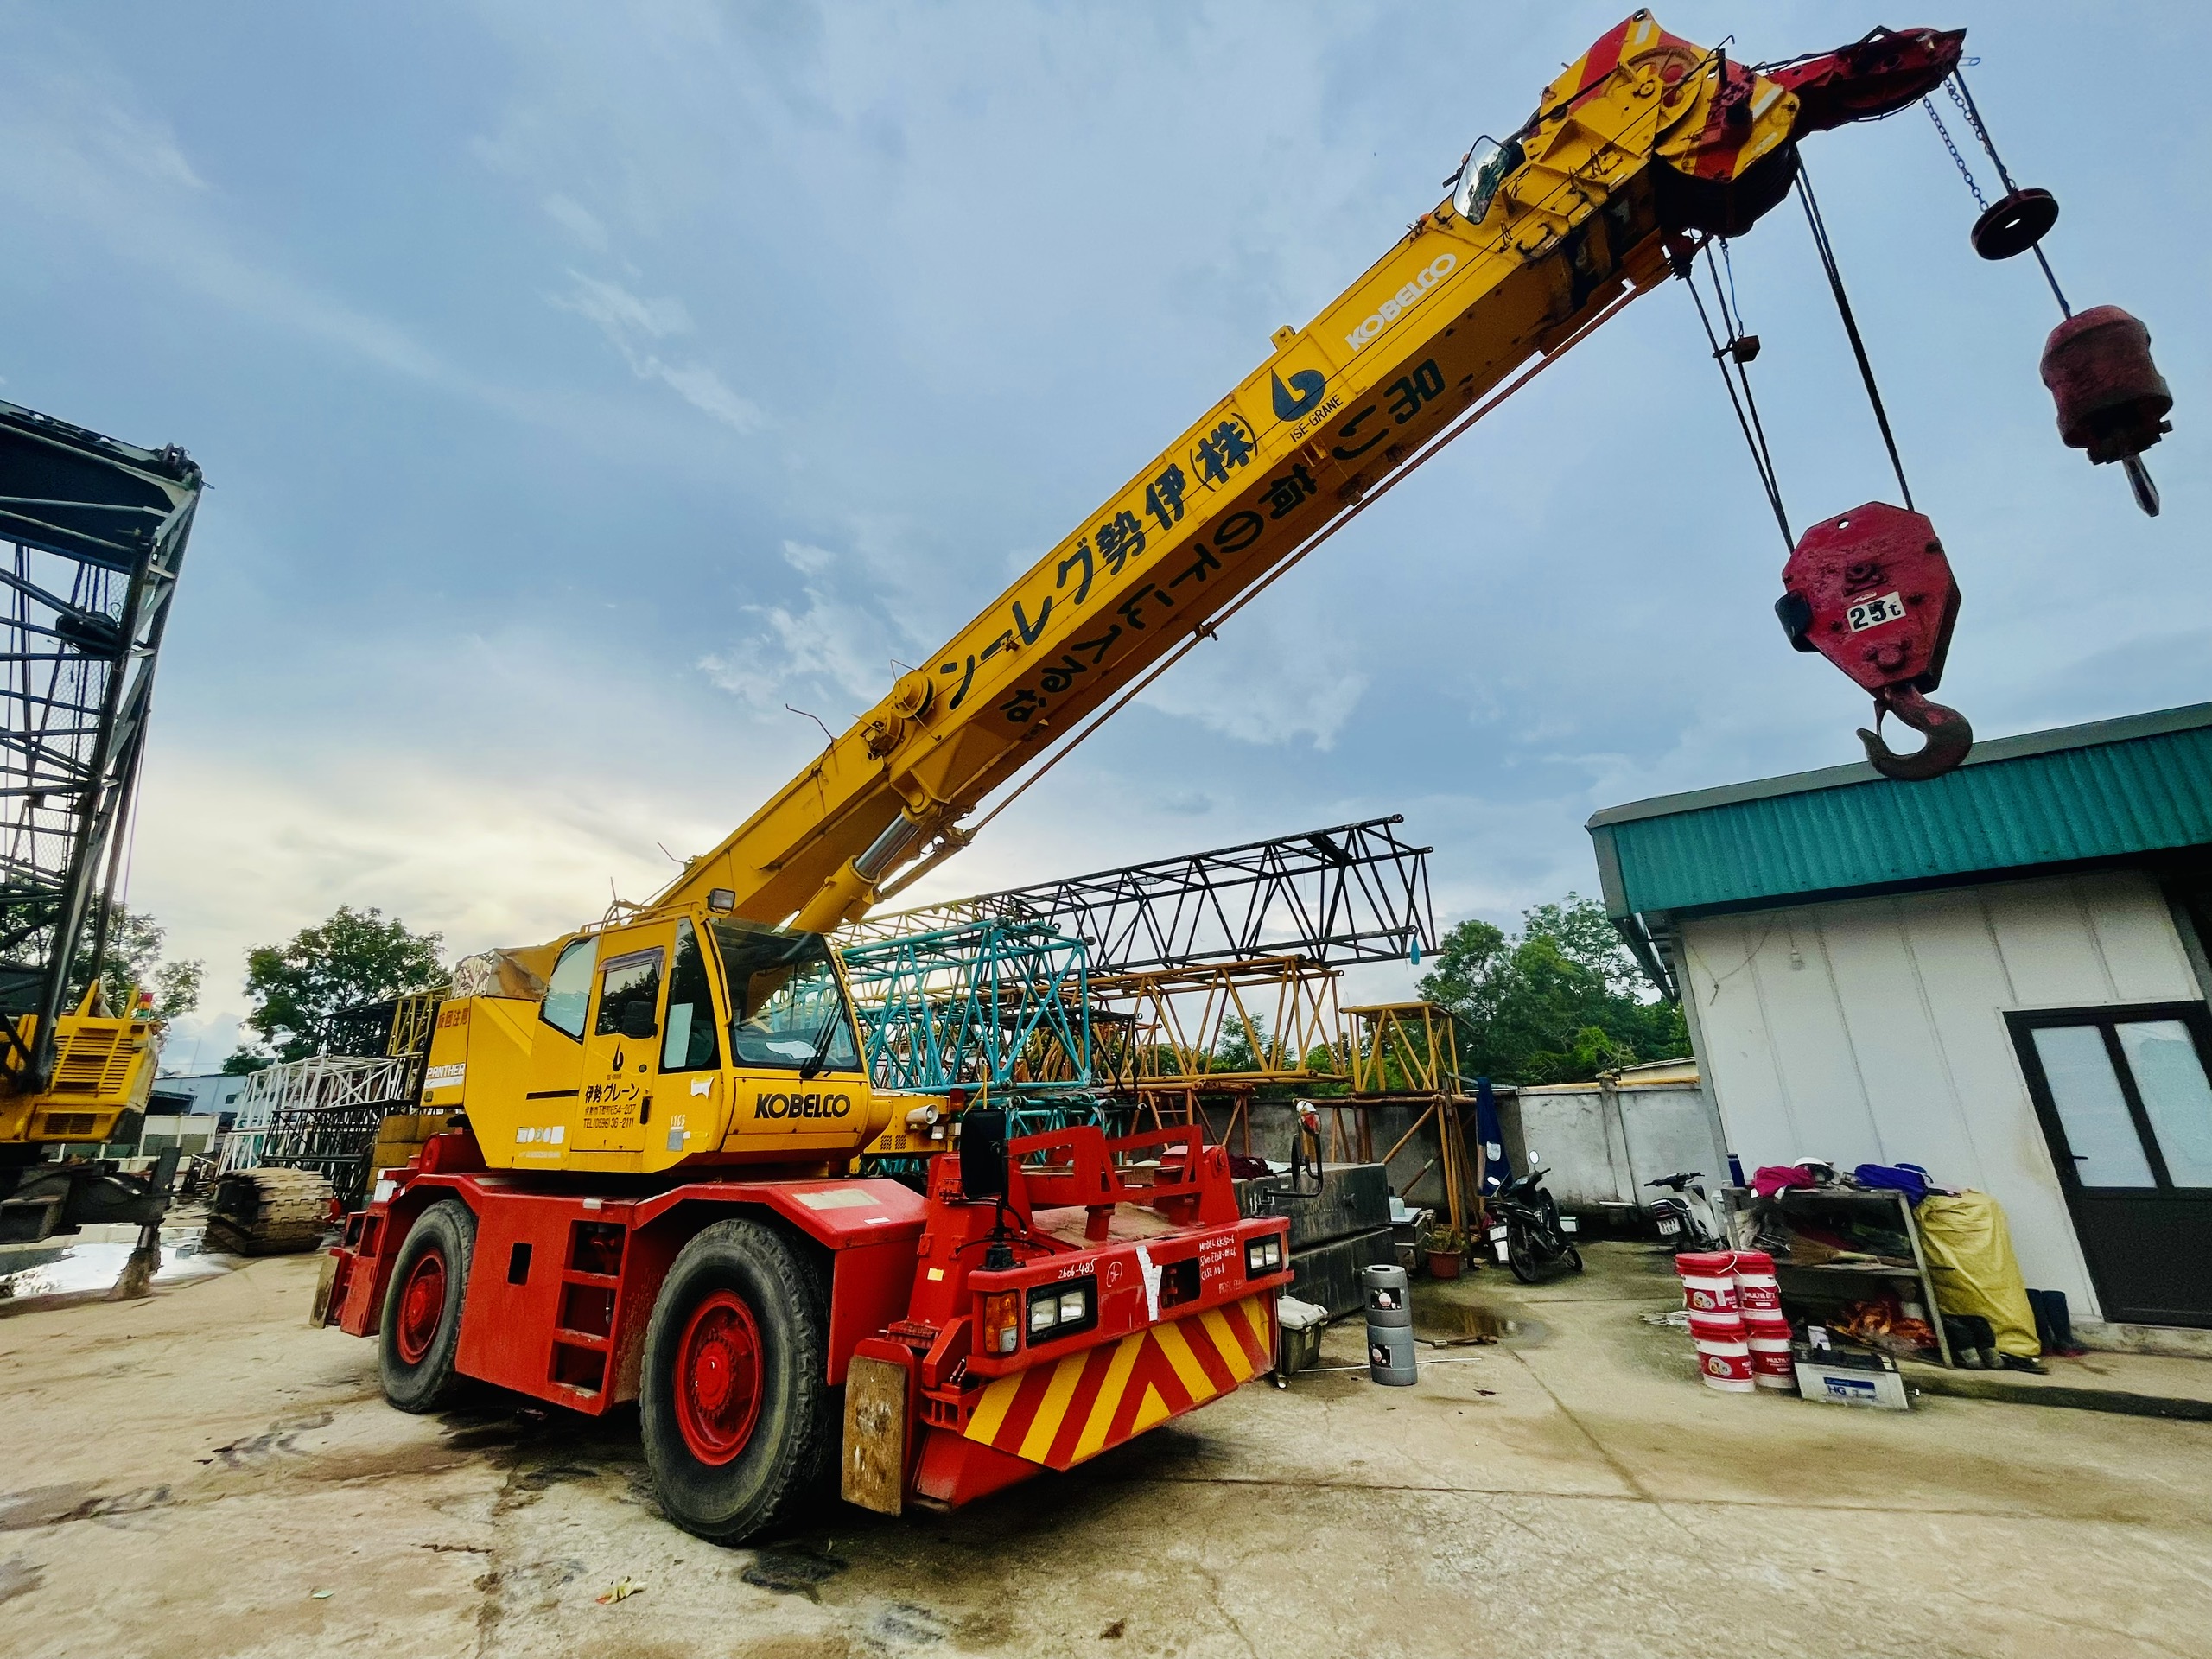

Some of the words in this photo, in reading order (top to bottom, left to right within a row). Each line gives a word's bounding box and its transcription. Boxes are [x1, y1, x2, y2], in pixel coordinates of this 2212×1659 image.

[1344, 253, 1458, 353] KOBELCO
[1290, 394, 1344, 443] ISE-GRANE
[426, 1063, 466, 1079] PANTHER
[754, 1092, 851, 1120] KOBELCO
